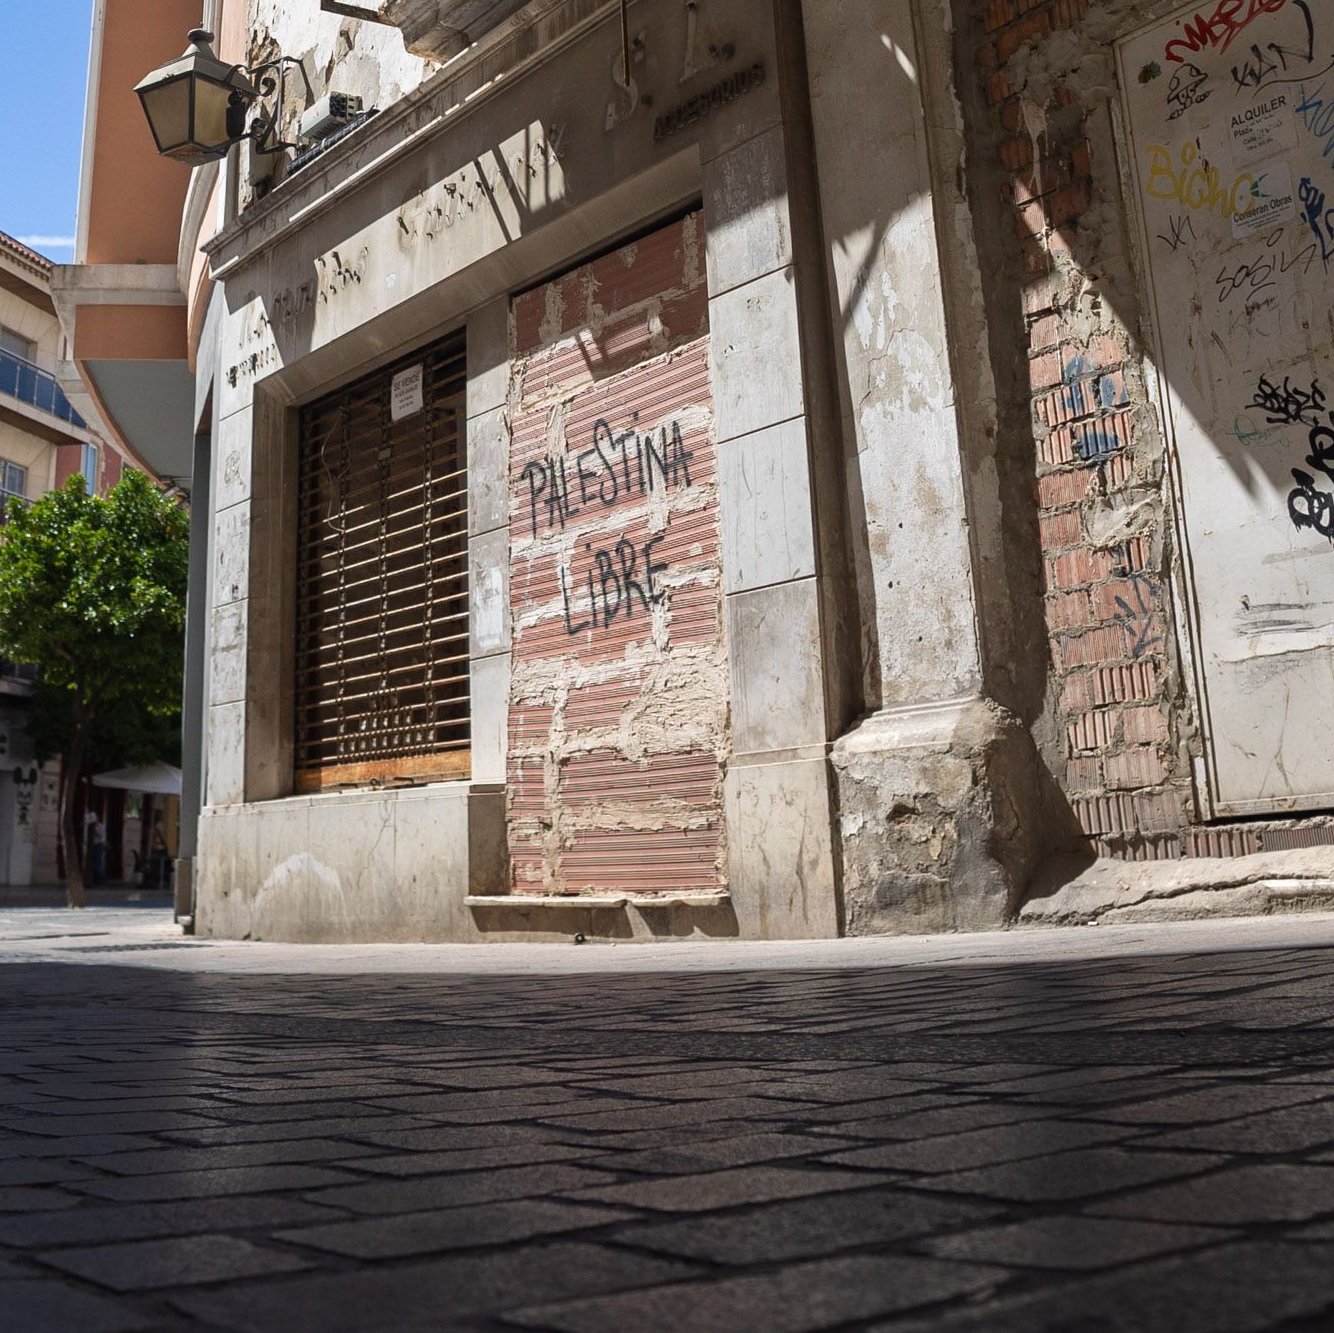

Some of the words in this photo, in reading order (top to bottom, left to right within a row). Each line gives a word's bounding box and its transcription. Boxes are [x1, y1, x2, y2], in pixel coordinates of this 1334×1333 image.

[1230, 96, 1287, 129] ALQUILER
[1269, 194, 1294, 212] Obras
[521, 411, 695, 539] PALESTINA
[559, 535, 671, 636] LIBRE
